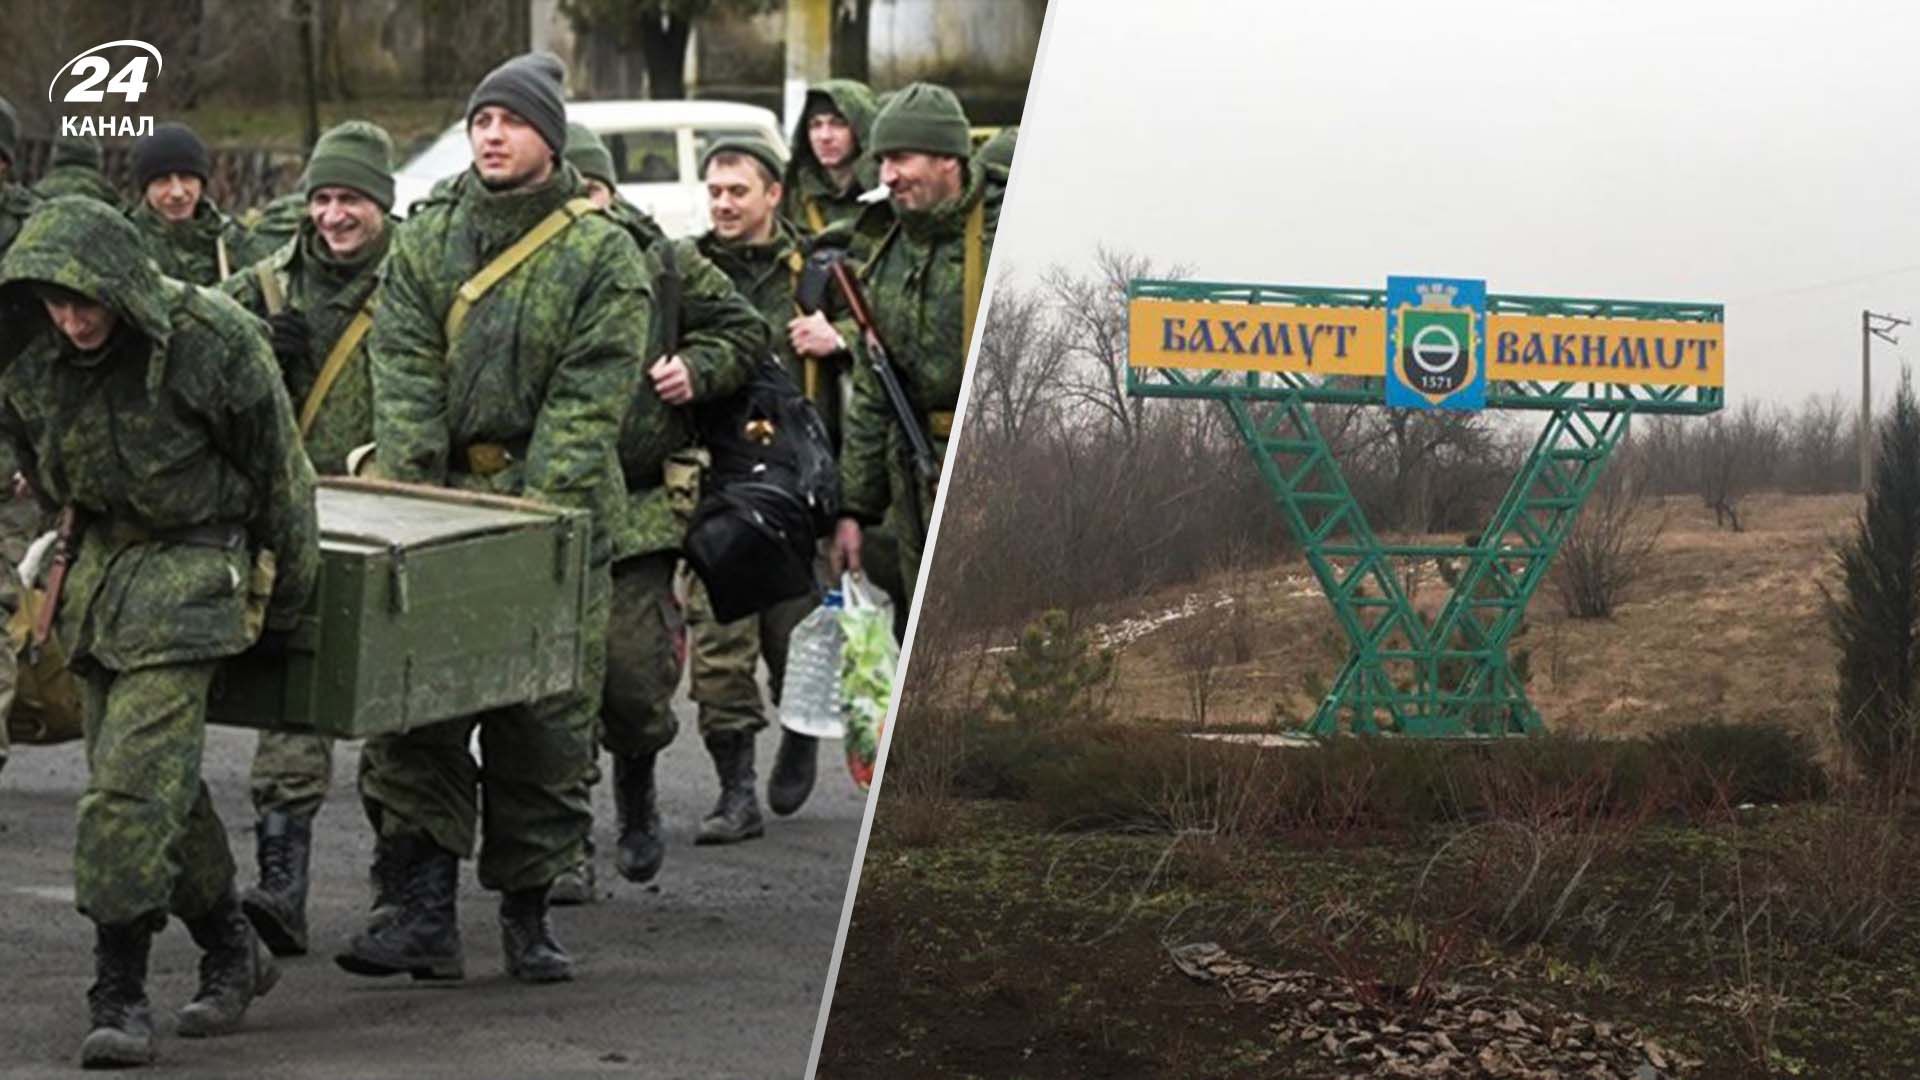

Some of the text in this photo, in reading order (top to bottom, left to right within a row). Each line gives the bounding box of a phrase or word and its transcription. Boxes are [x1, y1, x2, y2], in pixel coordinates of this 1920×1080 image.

[1161, 317, 1358, 367] БАХМУТ
[1496, 330, 1718, 371] BAKHMUT
[1421, 375, 1453, 389] 1571
